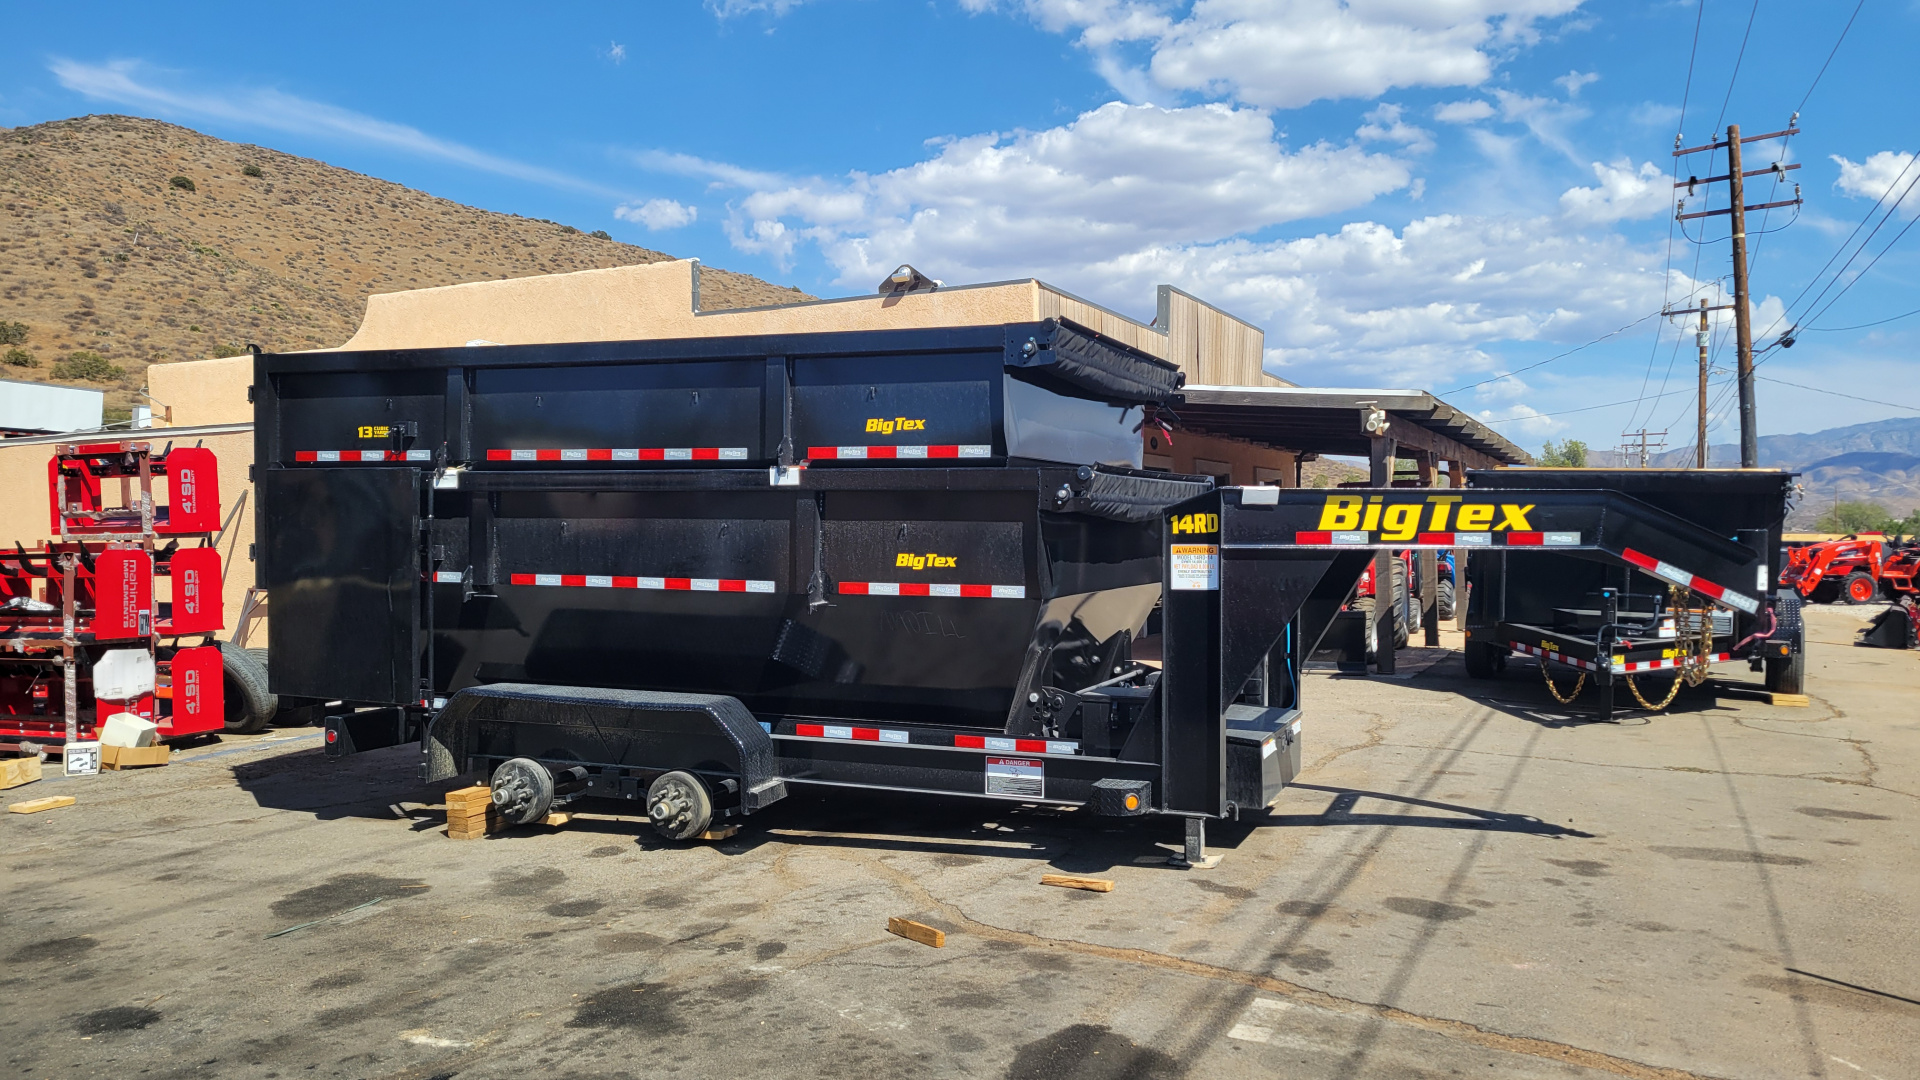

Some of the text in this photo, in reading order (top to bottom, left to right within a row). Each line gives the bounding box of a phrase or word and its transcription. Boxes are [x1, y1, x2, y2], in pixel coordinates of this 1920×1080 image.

[358, 426, 372, 438] 13
[866, 417, 926, 434] BigTex
[1171, 513, 1218, 534] 14RD
[1318, 495, 1536, 541] BigTex
[896, 553, 957, 570] BigTex
[129, 560, 138, 628] mahindra
[1662, 648, 1687, 659] BigT
